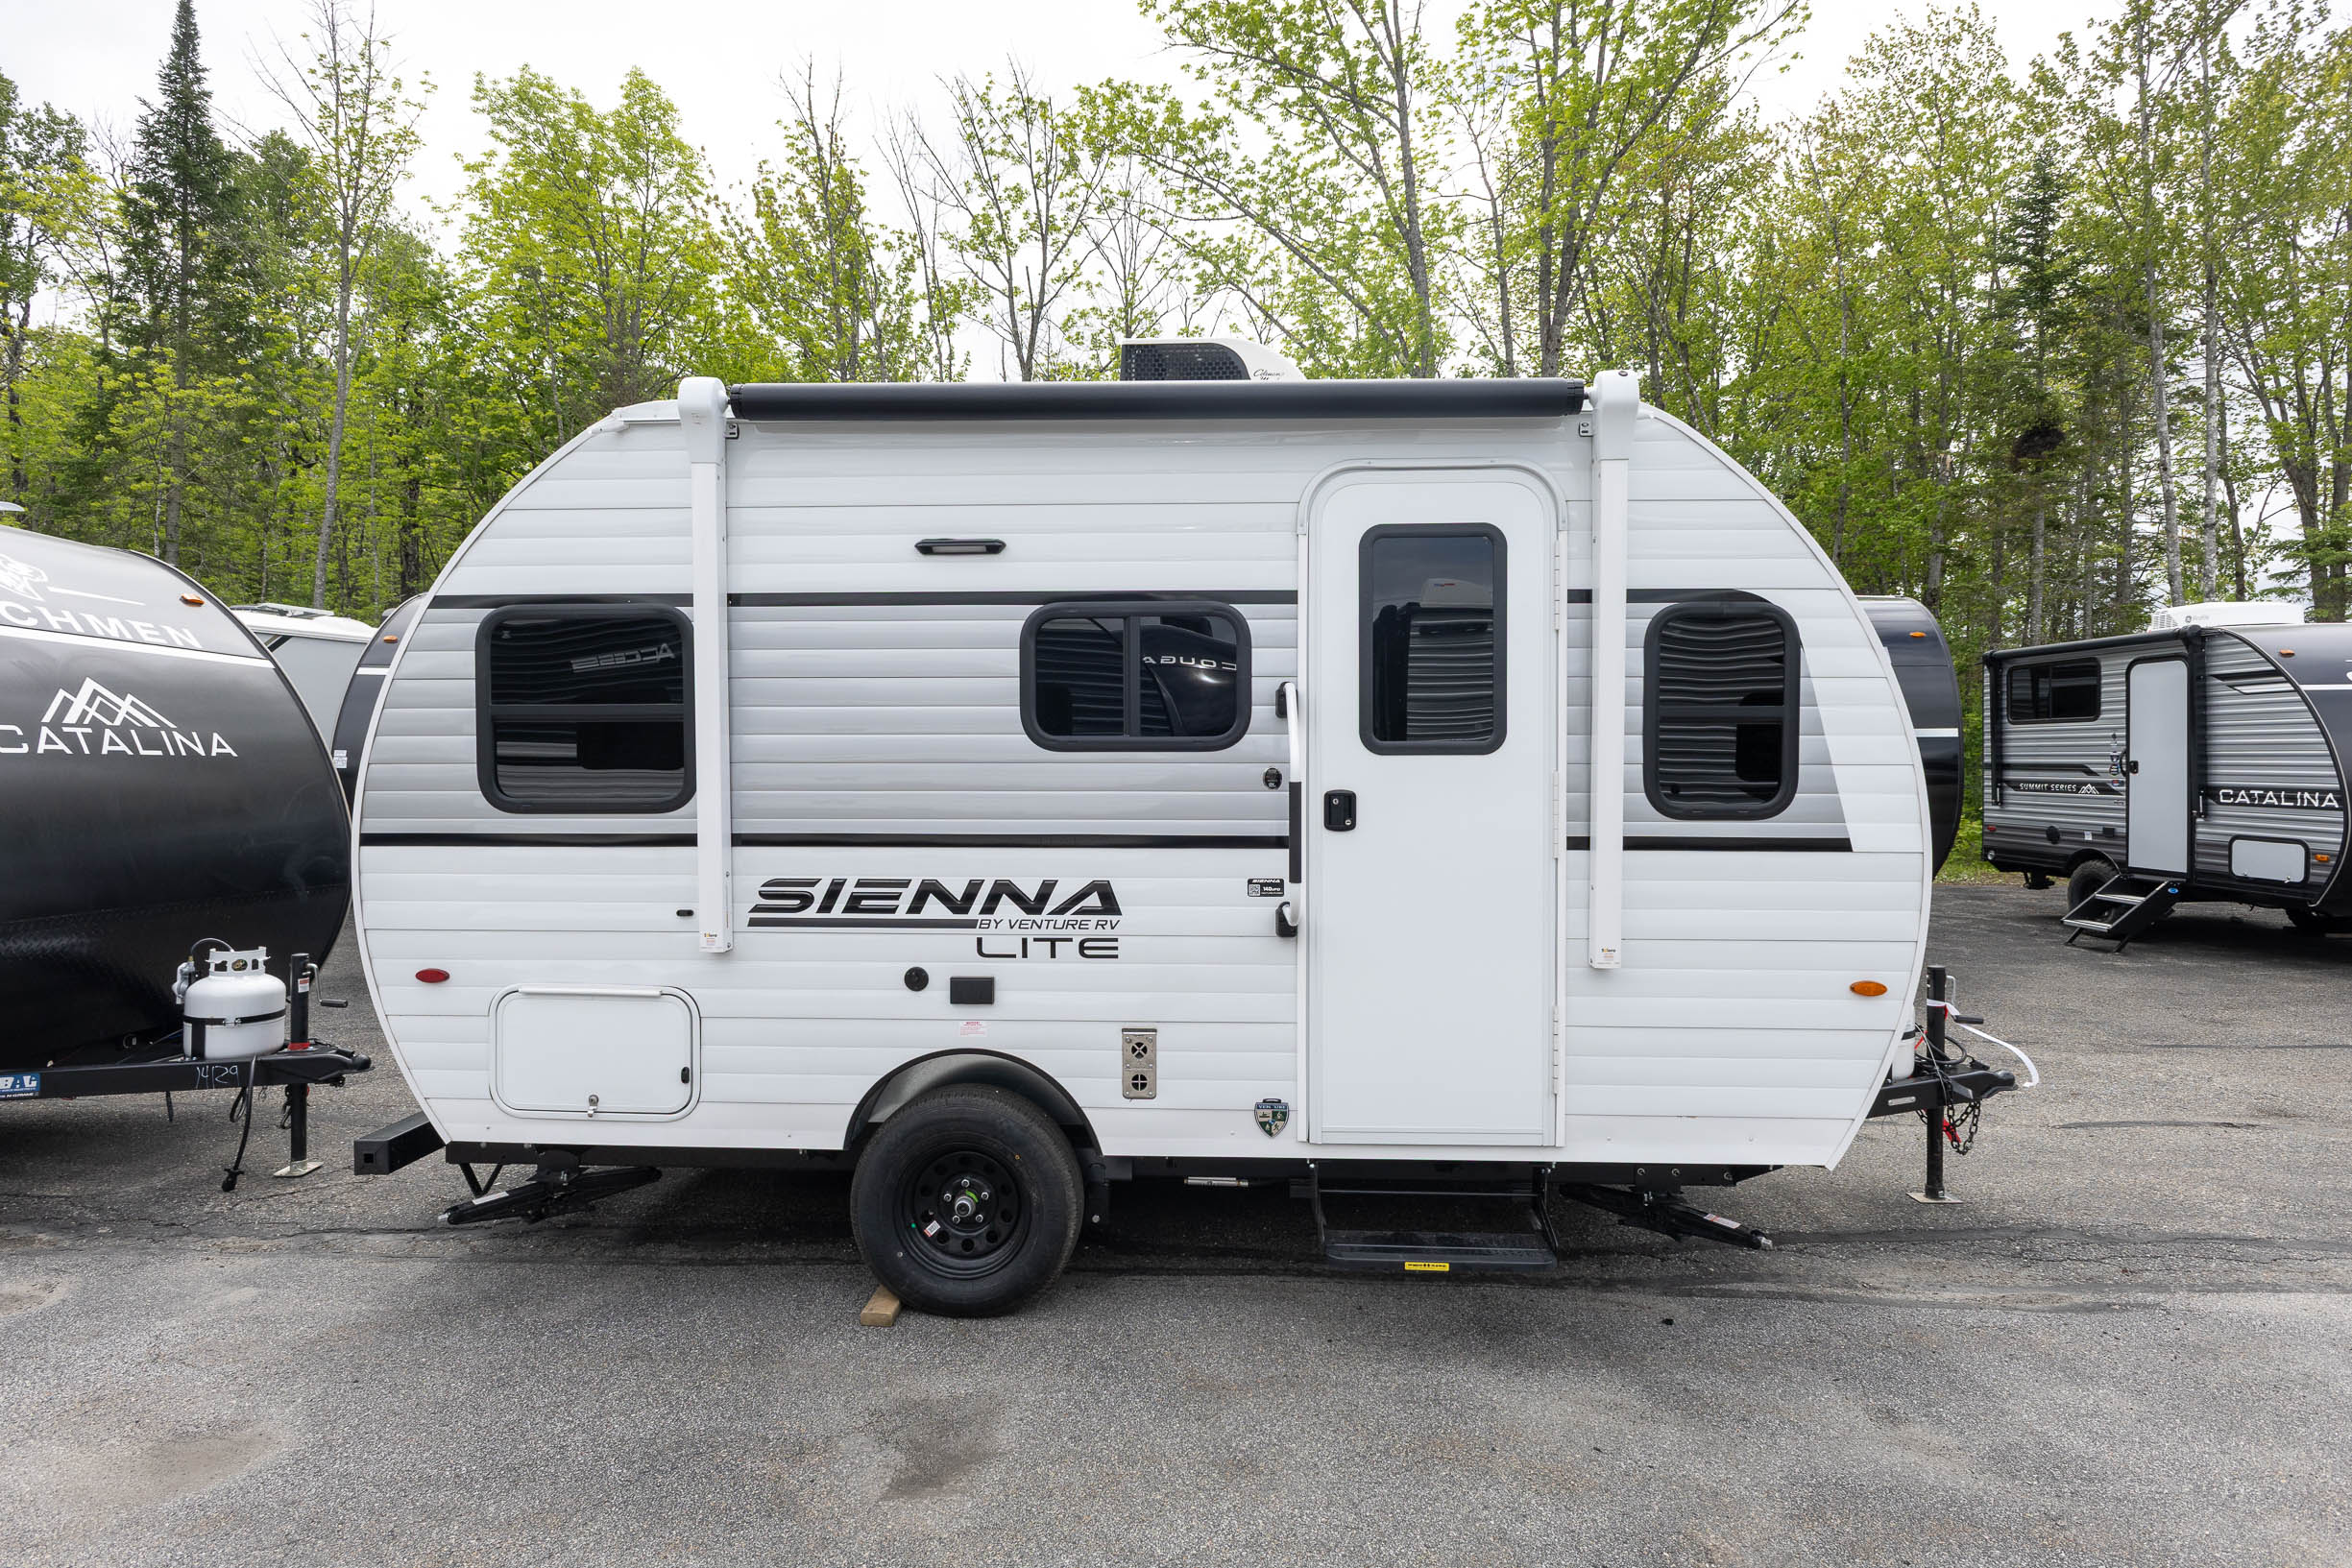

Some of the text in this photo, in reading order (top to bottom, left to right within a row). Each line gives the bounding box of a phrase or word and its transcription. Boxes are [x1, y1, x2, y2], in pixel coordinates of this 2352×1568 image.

[0, 724, 239, 757] CATALINA
[2050, 784, 2076, 792] SERIES
[2219, 788, 2340, 808] CATALINA
[748, 878, 1123, 916] SIENNA
[978, 919, 1121, 930] BY VENTURE RV
[976, 936, 1119, 959] LITE
